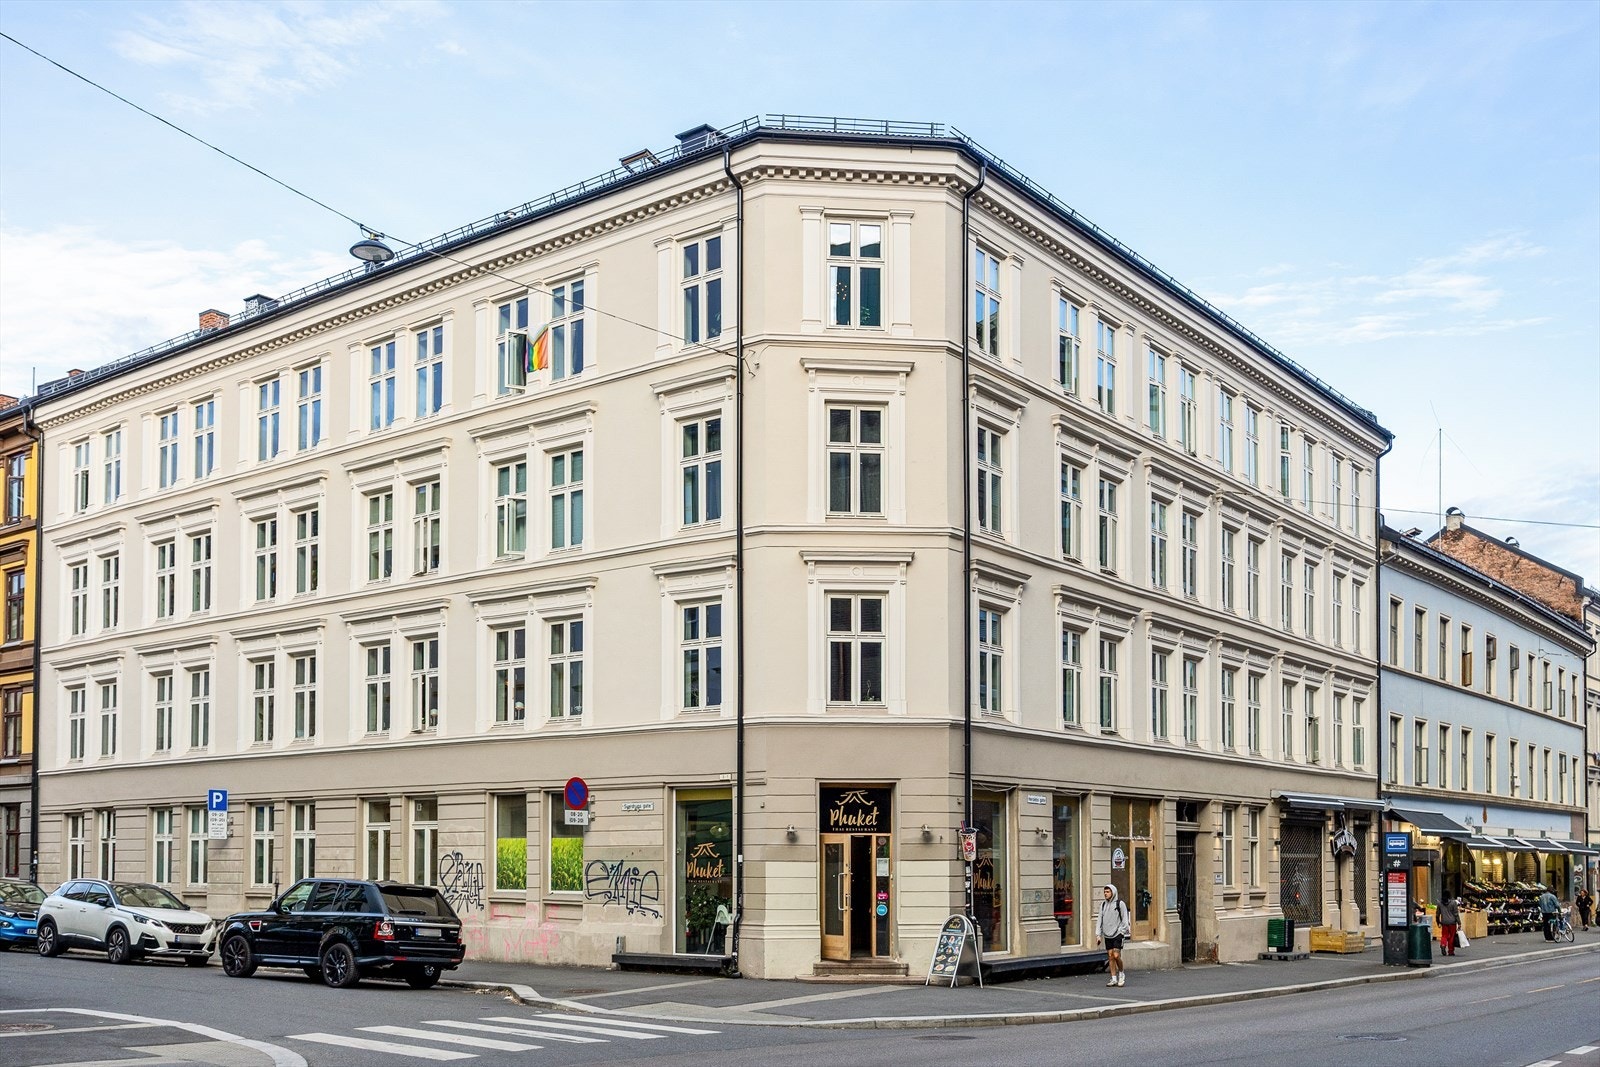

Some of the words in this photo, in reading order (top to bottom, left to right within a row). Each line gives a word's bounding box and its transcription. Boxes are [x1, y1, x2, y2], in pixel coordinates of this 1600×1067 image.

[212, 792, 223, 808] P
[829, 805, 880, 827] Phuket
[686, 858, 724, 879] Phuket
